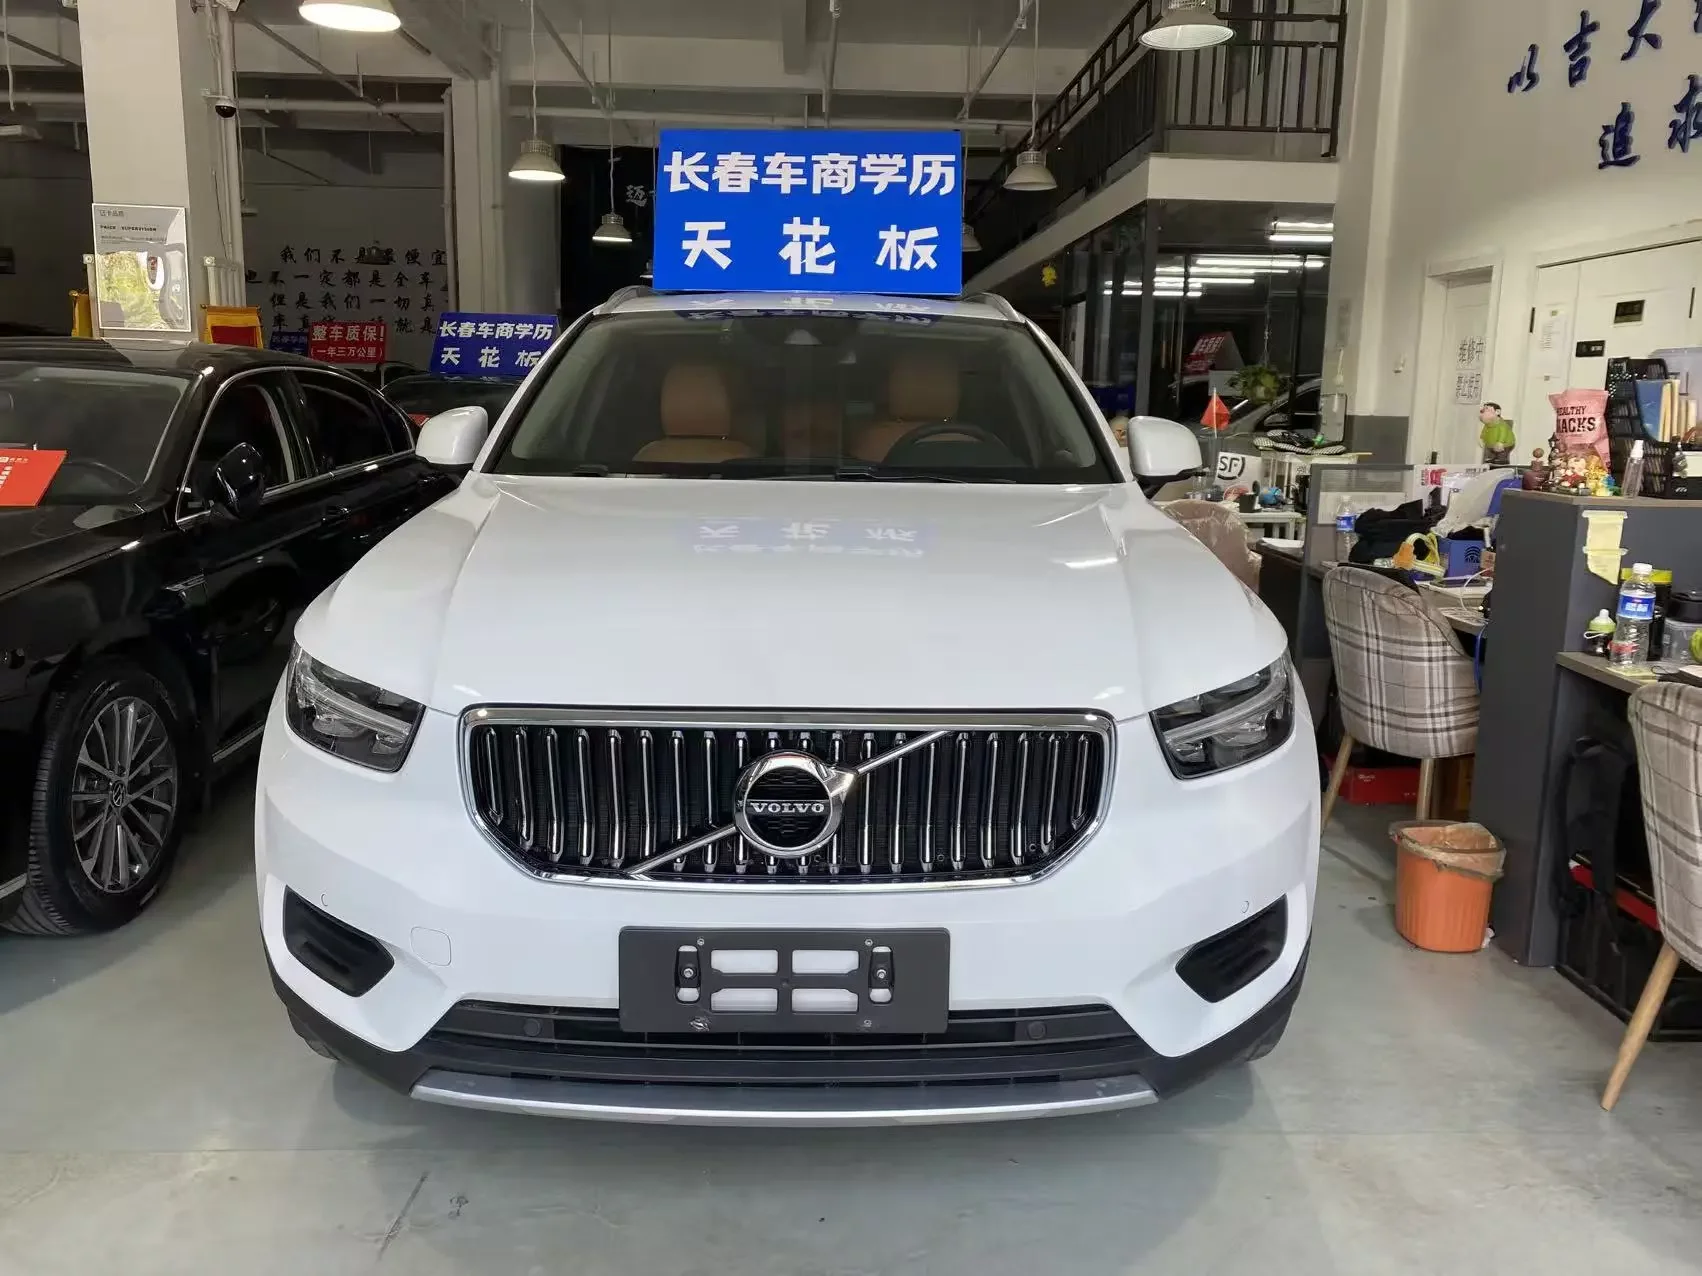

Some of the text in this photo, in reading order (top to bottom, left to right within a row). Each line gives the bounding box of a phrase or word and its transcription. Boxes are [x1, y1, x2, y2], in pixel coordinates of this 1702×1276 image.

[1507, 0, 1702, 93] 以吉大
[663, 150, 957, 196] 长春车商学历
[681, 216, 940, 275] 天花板
[439, 320, 554, 341] 长春车商学历
[1557, 416, 1596, 433] ACKS
[750, 802, 825, 813] VOLVO
